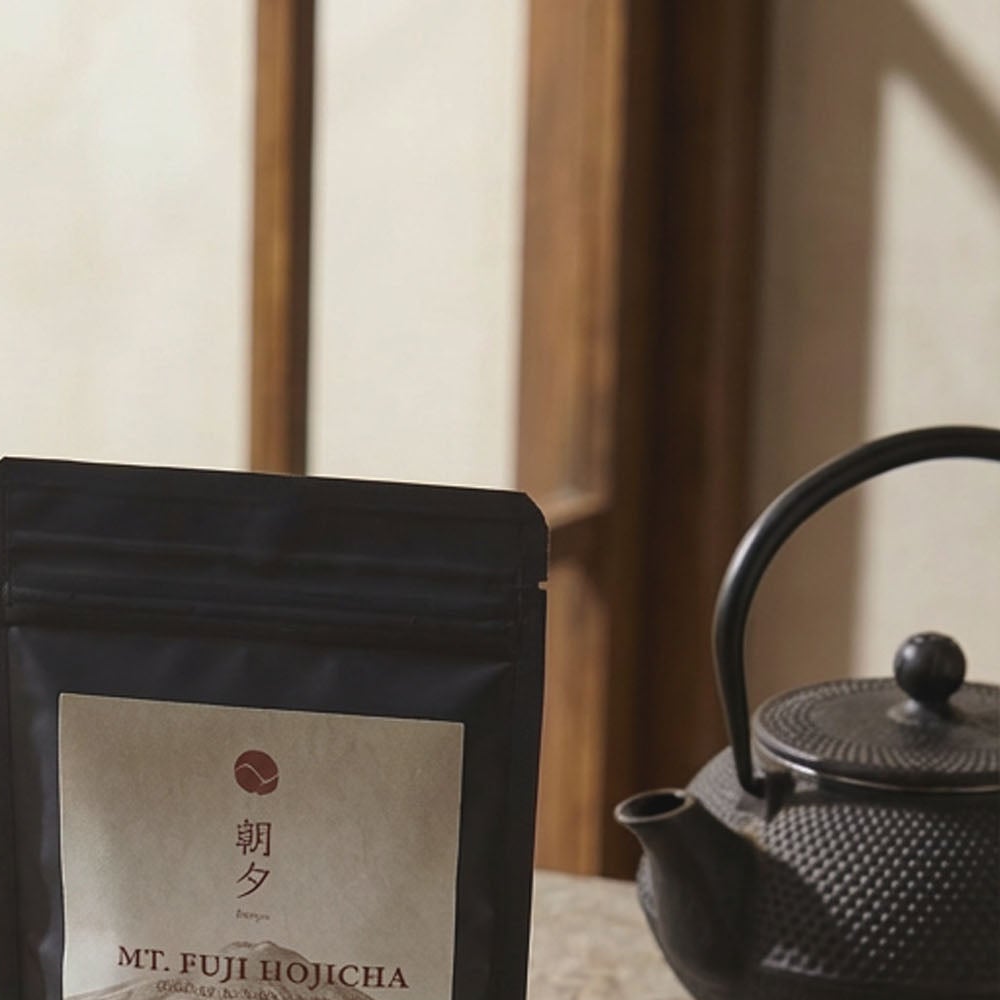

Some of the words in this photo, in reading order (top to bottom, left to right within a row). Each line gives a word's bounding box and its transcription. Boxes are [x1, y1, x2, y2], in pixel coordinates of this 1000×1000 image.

[235, 818, 272, 899] 朝夕
[117, 945, 170, 971] MT.
[180, 952, 248, 983] FUJI
[260, 960, 410, 991] HOJICHA
